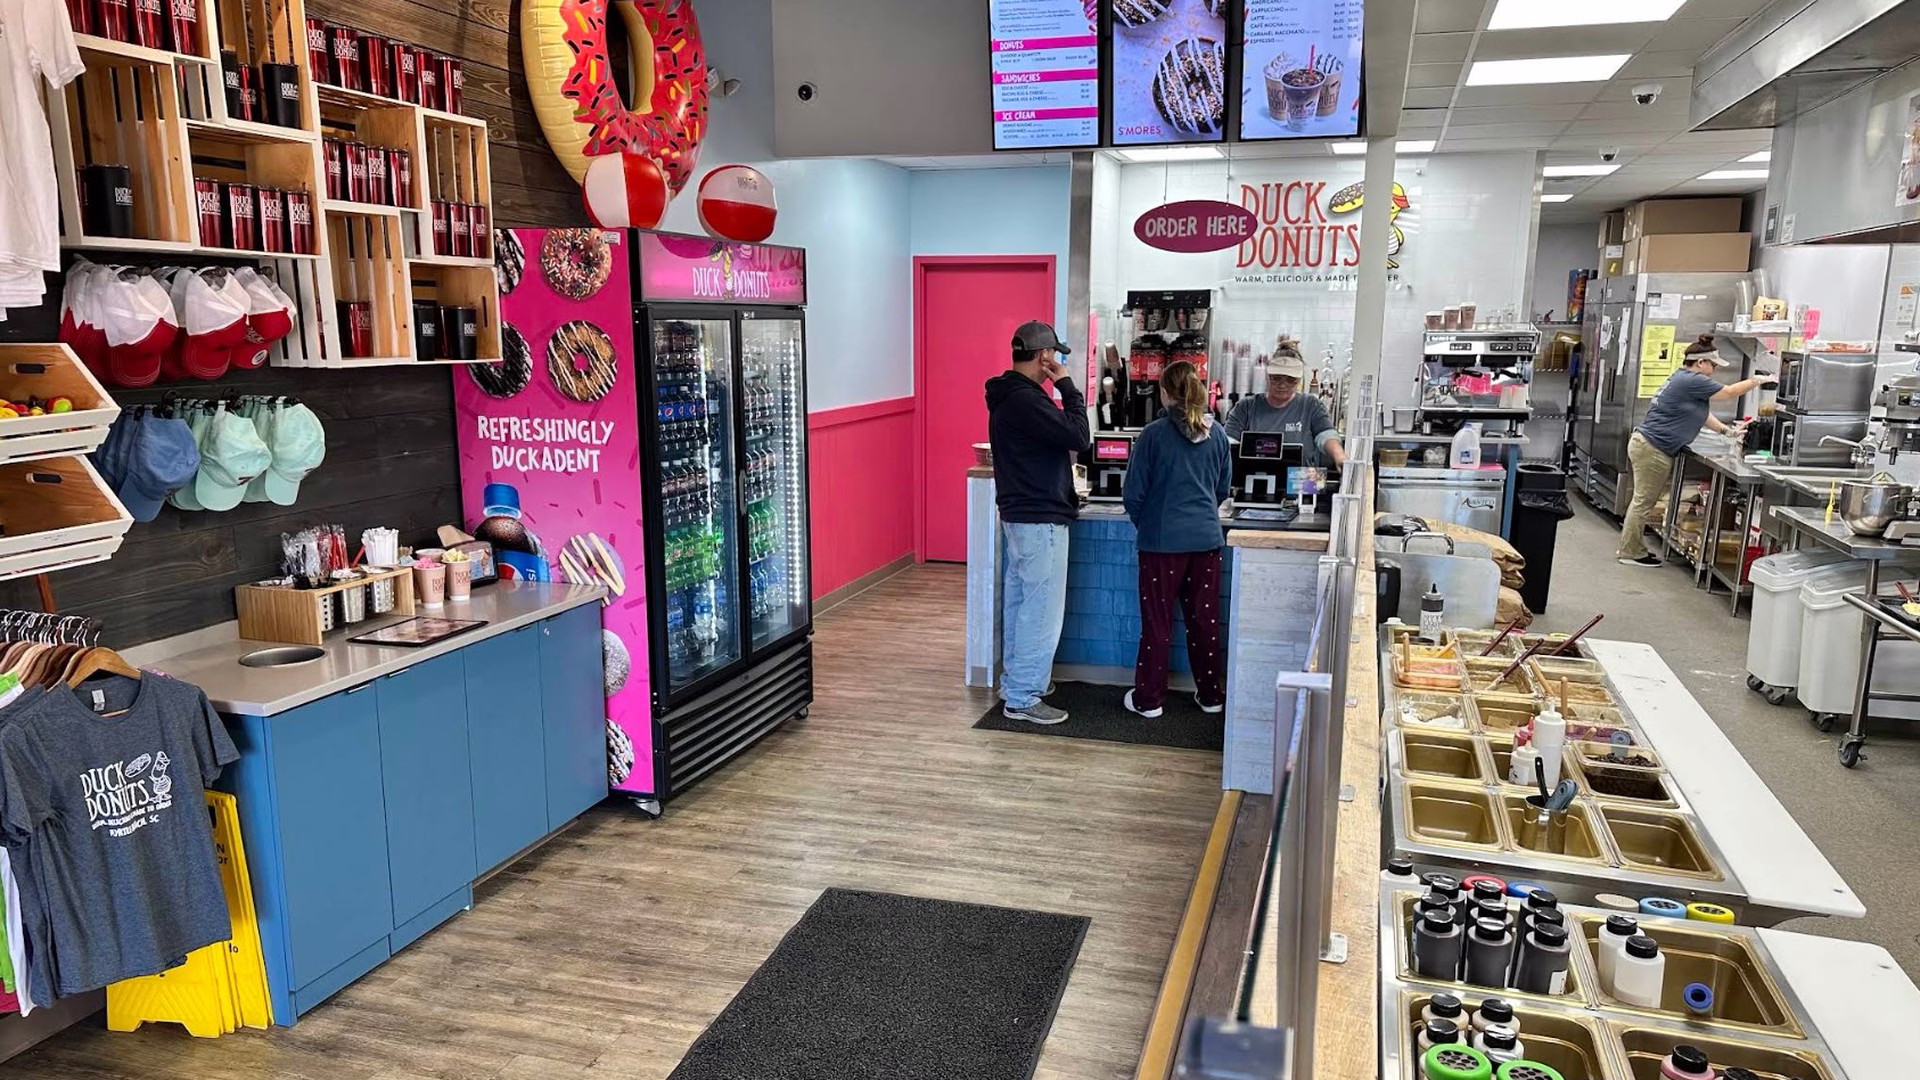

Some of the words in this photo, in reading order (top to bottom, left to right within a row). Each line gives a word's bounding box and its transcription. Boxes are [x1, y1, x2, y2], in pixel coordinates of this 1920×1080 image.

[1000, 41, 1024, 51] DONUTS
[1001, 73, 1040, 83] SANDWICHES
[1002, 112, 1013, 121] ICE
[1014, 111, 1036, 120] CREAM
[1118, 126, 1161, 135] S'MORES
[1241, 181, 1327, 225] DUCK
[1145, 216, 1198, 238] ORDER
[1206, 215, 1248, 237] HERE
[1236, 224, 1360, 269] DONUTS
[692, 267, 723, 297] DUCK
[733, 270, 770, 299] DONUTS
[1235, 276, 1264, 284] WARM,
[1267, 275, 1313, 283] DELICIOUS
[1325, 274, 1350, 282] MADE
[477, 415, 614, 445] REFRESHINGLY
[492, 445, 601, 473] DUCKADENT
[80, 761, 126, 798] DUCK
[85, 780, 150, 821] DONUTS
[149, 814, 160, 823] SC
